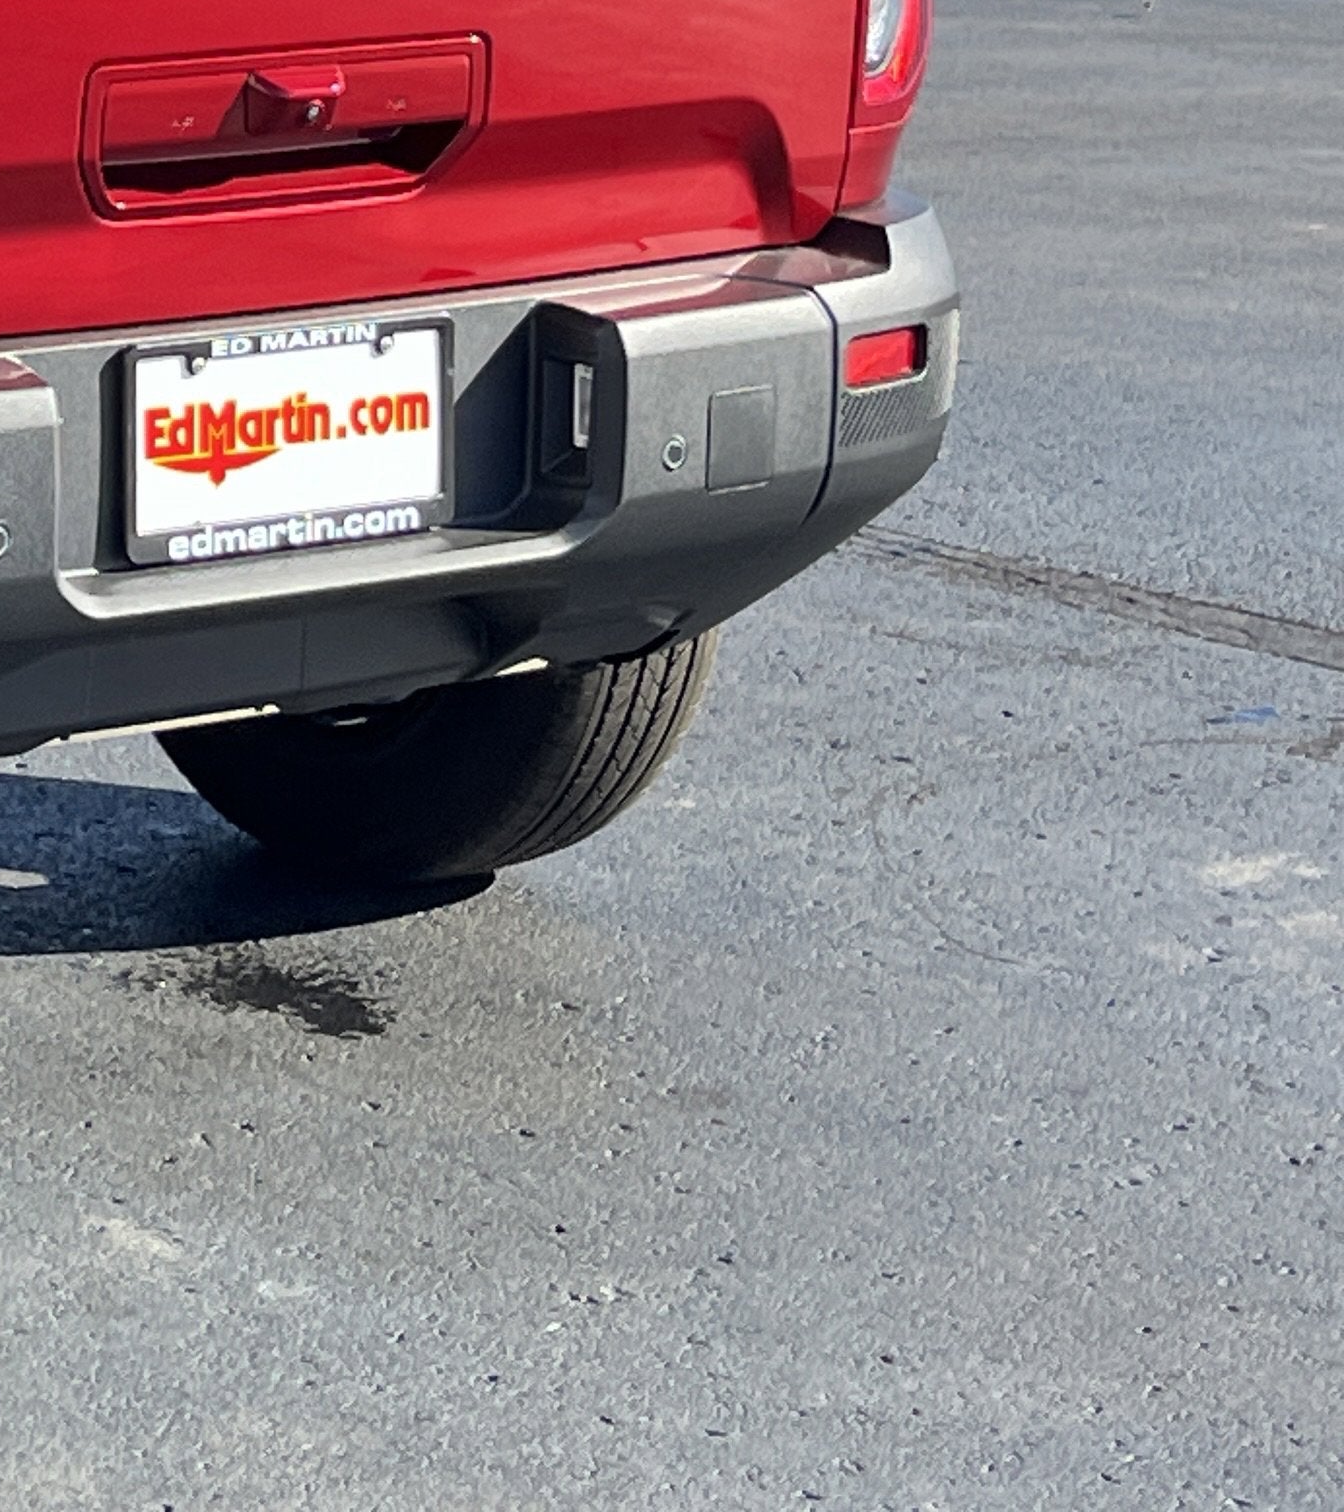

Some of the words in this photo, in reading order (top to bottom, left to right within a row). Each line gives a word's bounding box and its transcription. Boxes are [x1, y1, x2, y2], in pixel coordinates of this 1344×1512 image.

[211, 338, 253, 358] ED
[260, 323, 378, 353] MARTIN
[168, 505, 420, 562] edmartin.com
